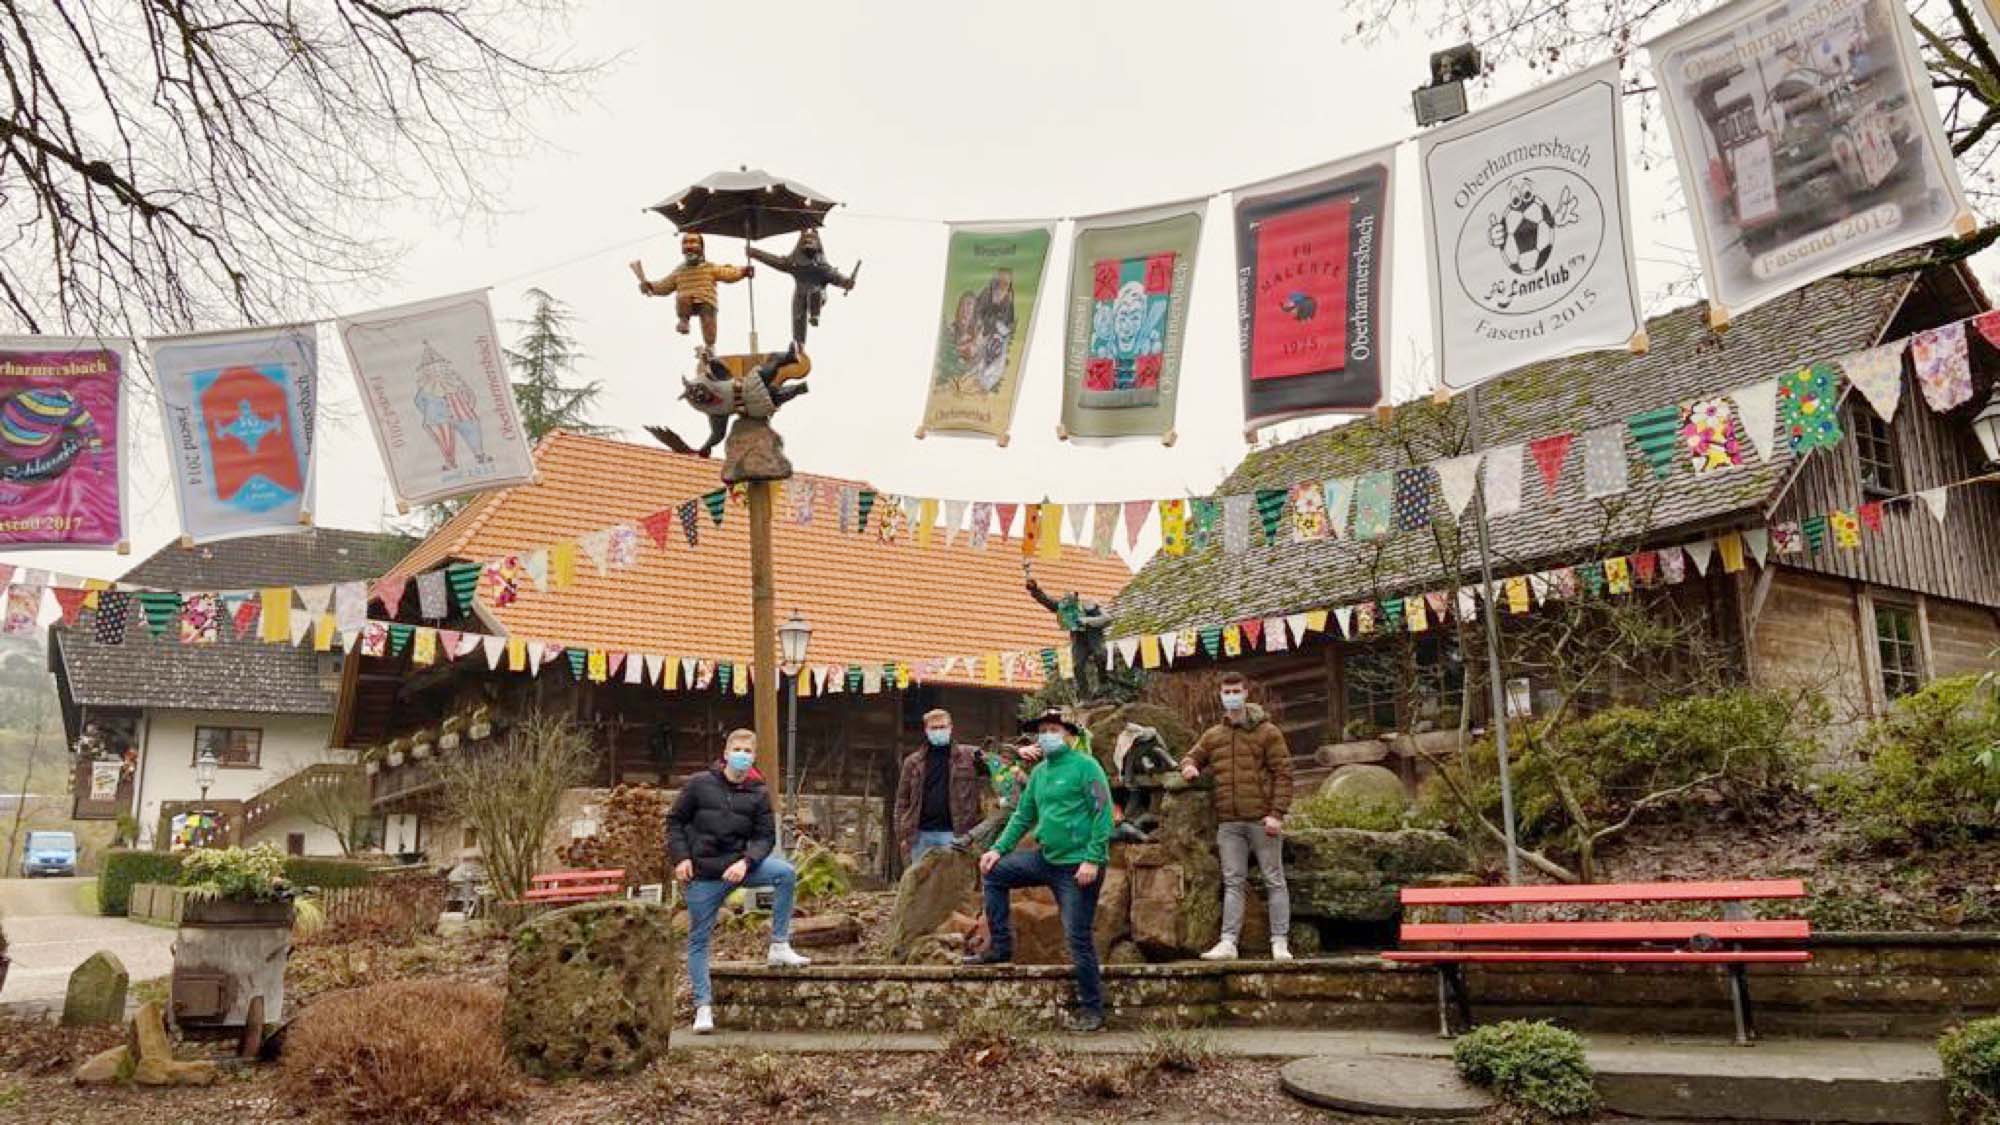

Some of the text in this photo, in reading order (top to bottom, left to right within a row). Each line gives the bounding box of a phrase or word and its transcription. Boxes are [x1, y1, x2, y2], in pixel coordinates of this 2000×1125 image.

[1454, 136, 1591, 208] Oberharmersbach
[1762, 206, 1898, 275] Fasend 2012
[1351, 215, 1375, 361] Oberharmersbach
[1475, 288, 1597, 341] Fasend 2015
[175, 406, 199, 450] Fasend
[43, 514, 82, 533] 2017
